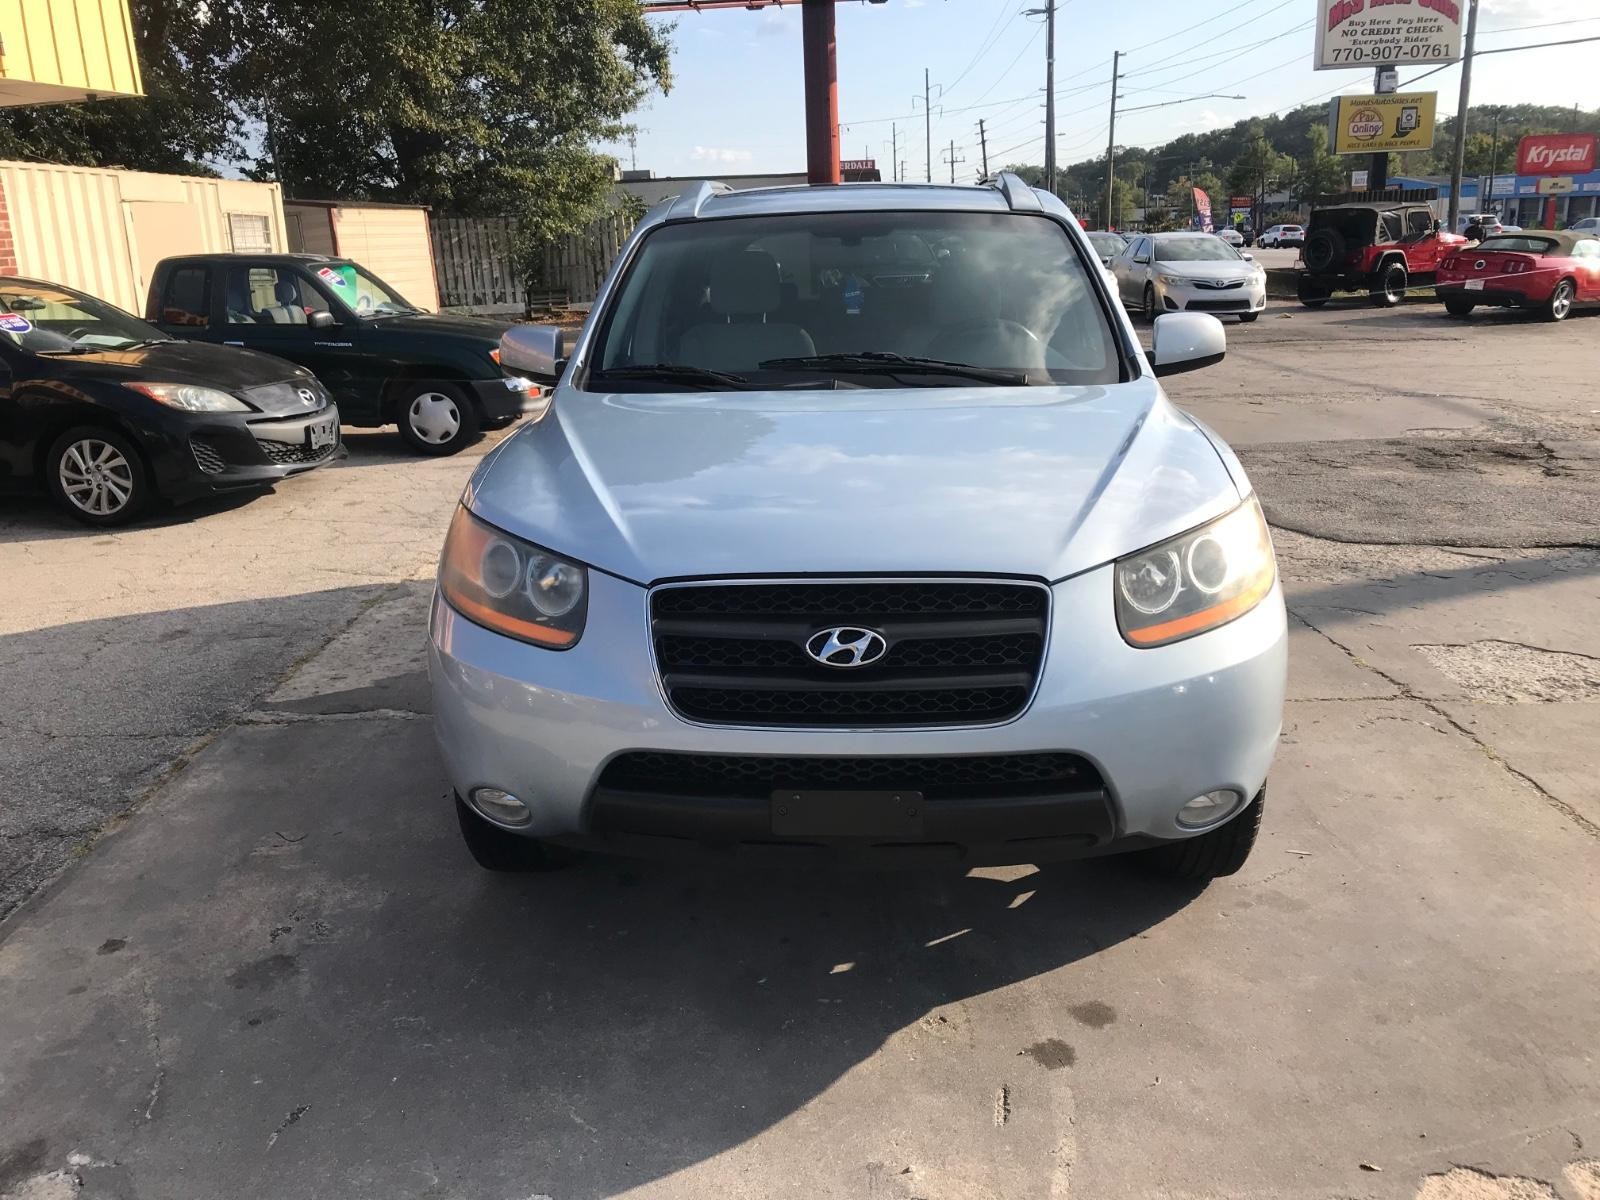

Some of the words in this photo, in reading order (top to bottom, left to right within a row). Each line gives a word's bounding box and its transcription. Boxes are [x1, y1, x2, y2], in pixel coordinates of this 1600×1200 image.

[1341, 28, 1357, 37] NO
[1361, 27, 1402, 36] CREDIT
[1406, 25, 1444, 34] CHECK
[1332, 44, 1451, 61] 770-907-0761
[1360, 110, 1375, 121] Pay
[1526, 144, 1591, 168] Krystal
